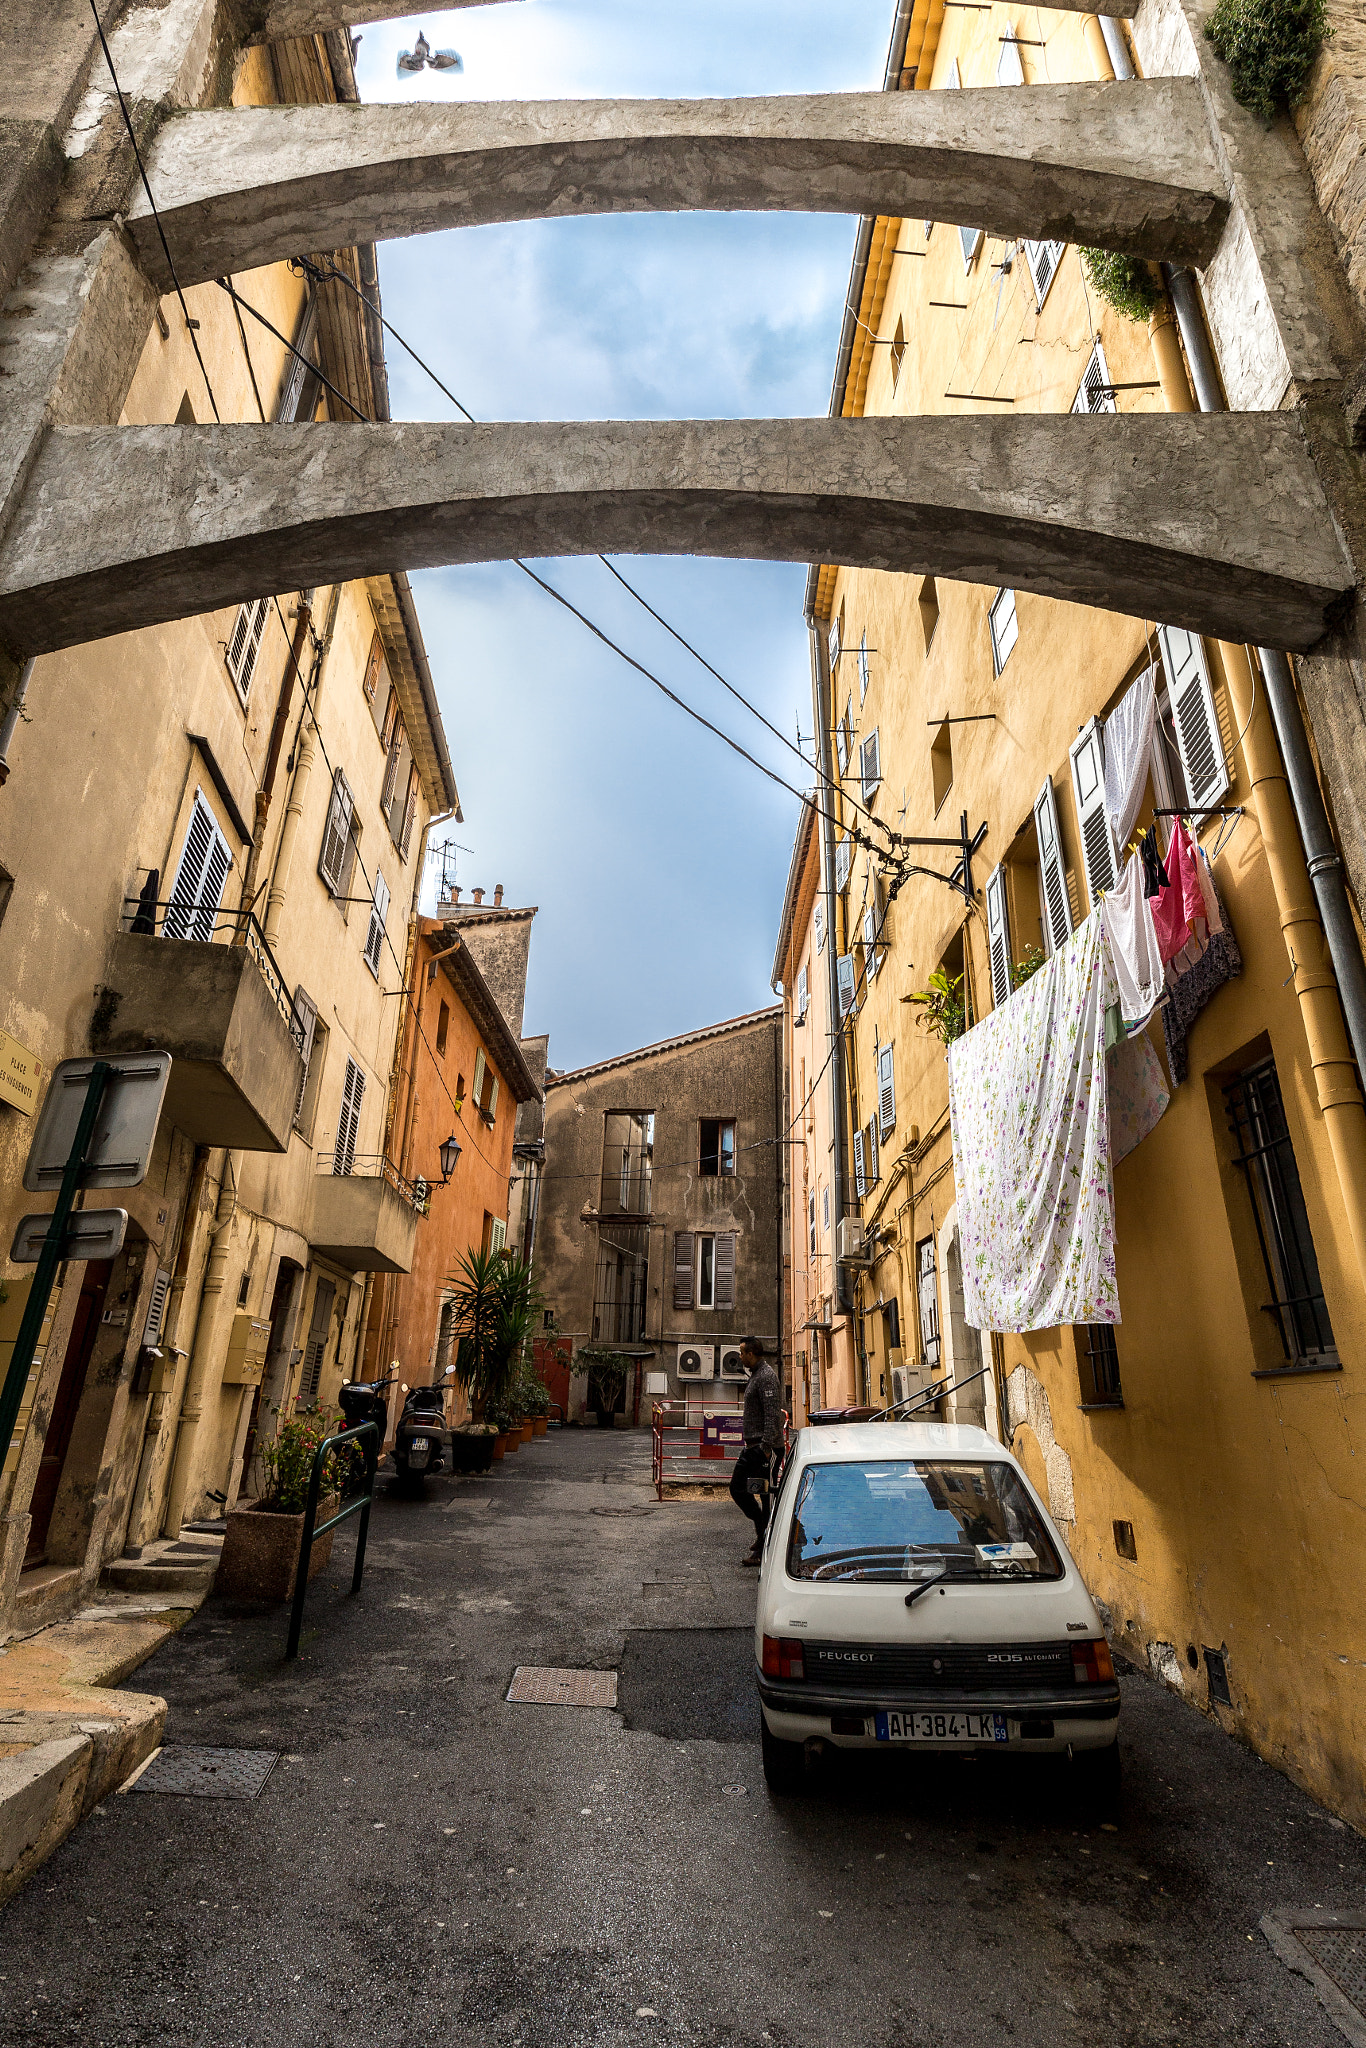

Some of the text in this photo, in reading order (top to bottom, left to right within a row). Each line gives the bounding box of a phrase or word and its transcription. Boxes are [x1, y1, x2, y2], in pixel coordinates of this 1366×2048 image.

[11, 1057, 26, 1075] PLACE
[6, 1073, 32, 1098] HUGUENOTS
[819, 1651, 875, 1662] PEUGEOT
[987, 1653, 1062, 1662] 205 AUTOMATIC
[890, 1714, 993, 1738] AH-384-LK
[995, 1728, 1007, 1739] 59
